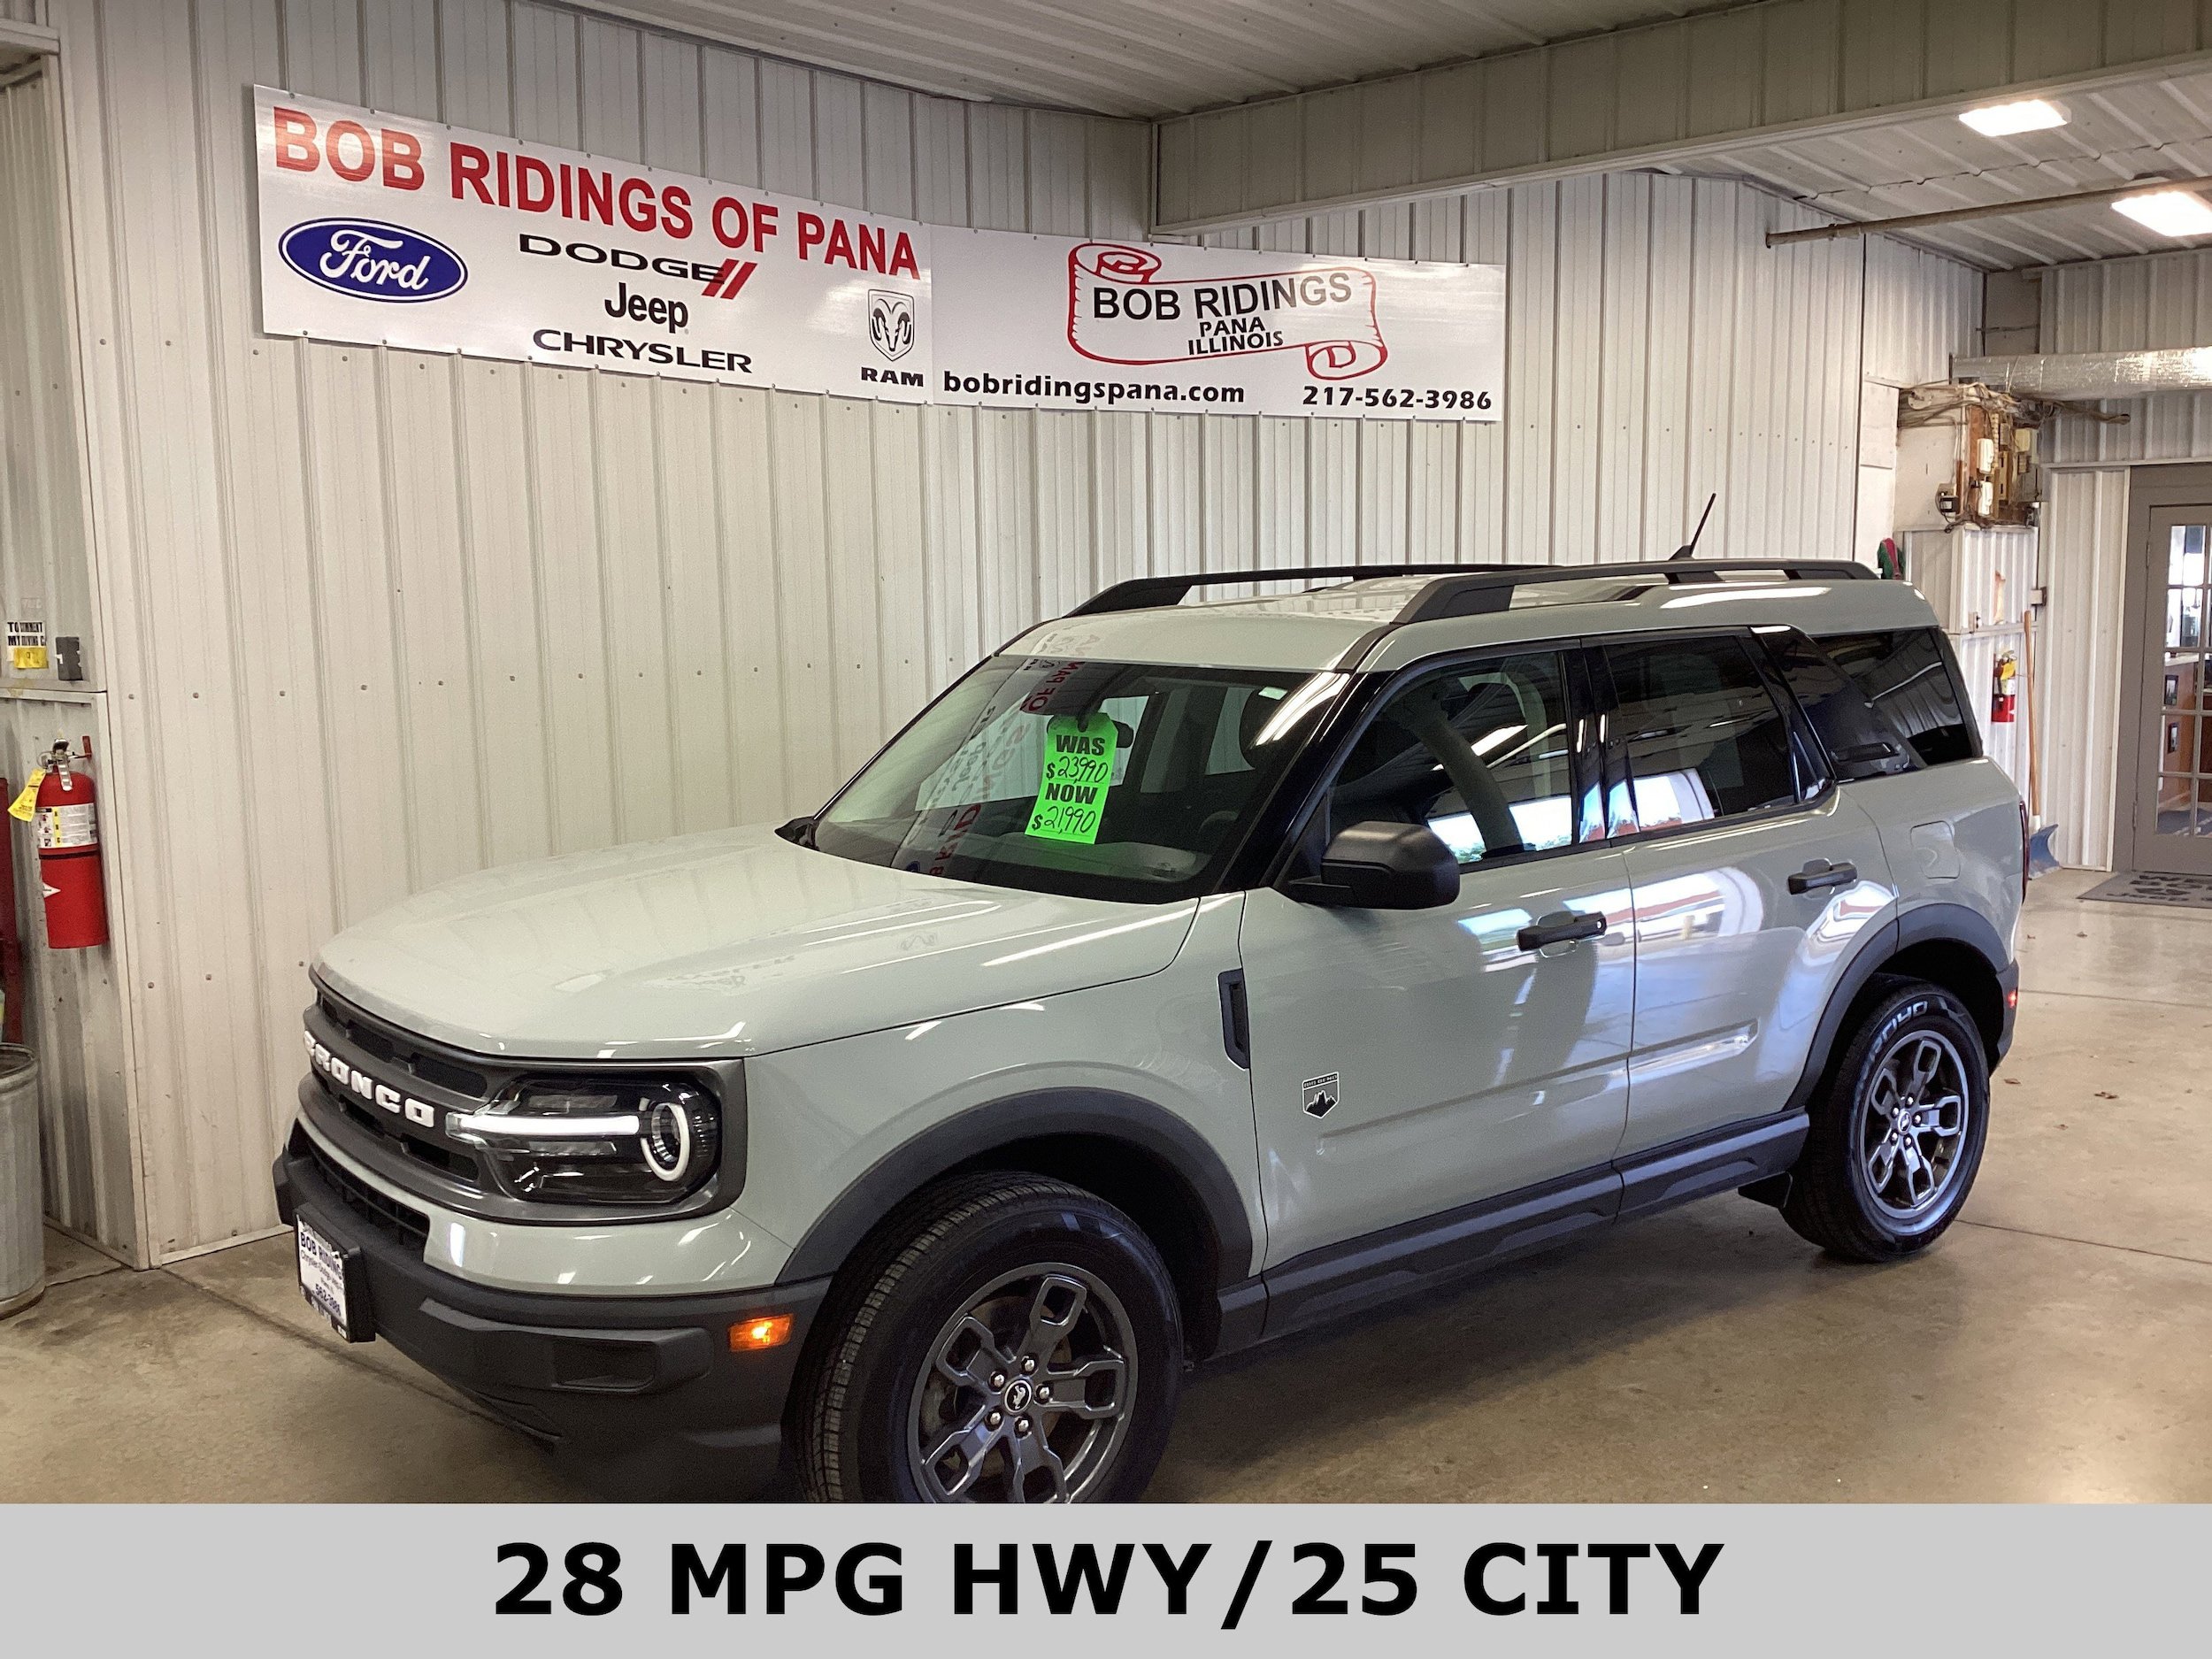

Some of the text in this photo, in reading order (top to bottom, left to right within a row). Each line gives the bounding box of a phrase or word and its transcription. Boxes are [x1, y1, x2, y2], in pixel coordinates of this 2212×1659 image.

[273, 105, 920, 280] BOB RIDINGS OF PANA
[319, 229, 431, 290] Ford
[518, 233, 726, 284] DODGE
[604, 281, 688, 334] Jeep
[1094, 271, 1353, 320] BOB RIDINGS
[1187, 330, 1284, 356] ILLINOIS
[1199, 316, 1266, 338] PANA
[533, 328, 753, 373] CHRYSLER
[860, 365, 925, 388] RAM
[943, 370, 1245, 405] bobridingspana.com
[1302, 386, 1493, 410] 217-562-3986
[1056, 734, 1106, 757] WAS
[1045, 782, 1099, 804] NOW
[303, 1030, 435, 1128] BRONCO
[300, 1231, 318, 1256] BOB
